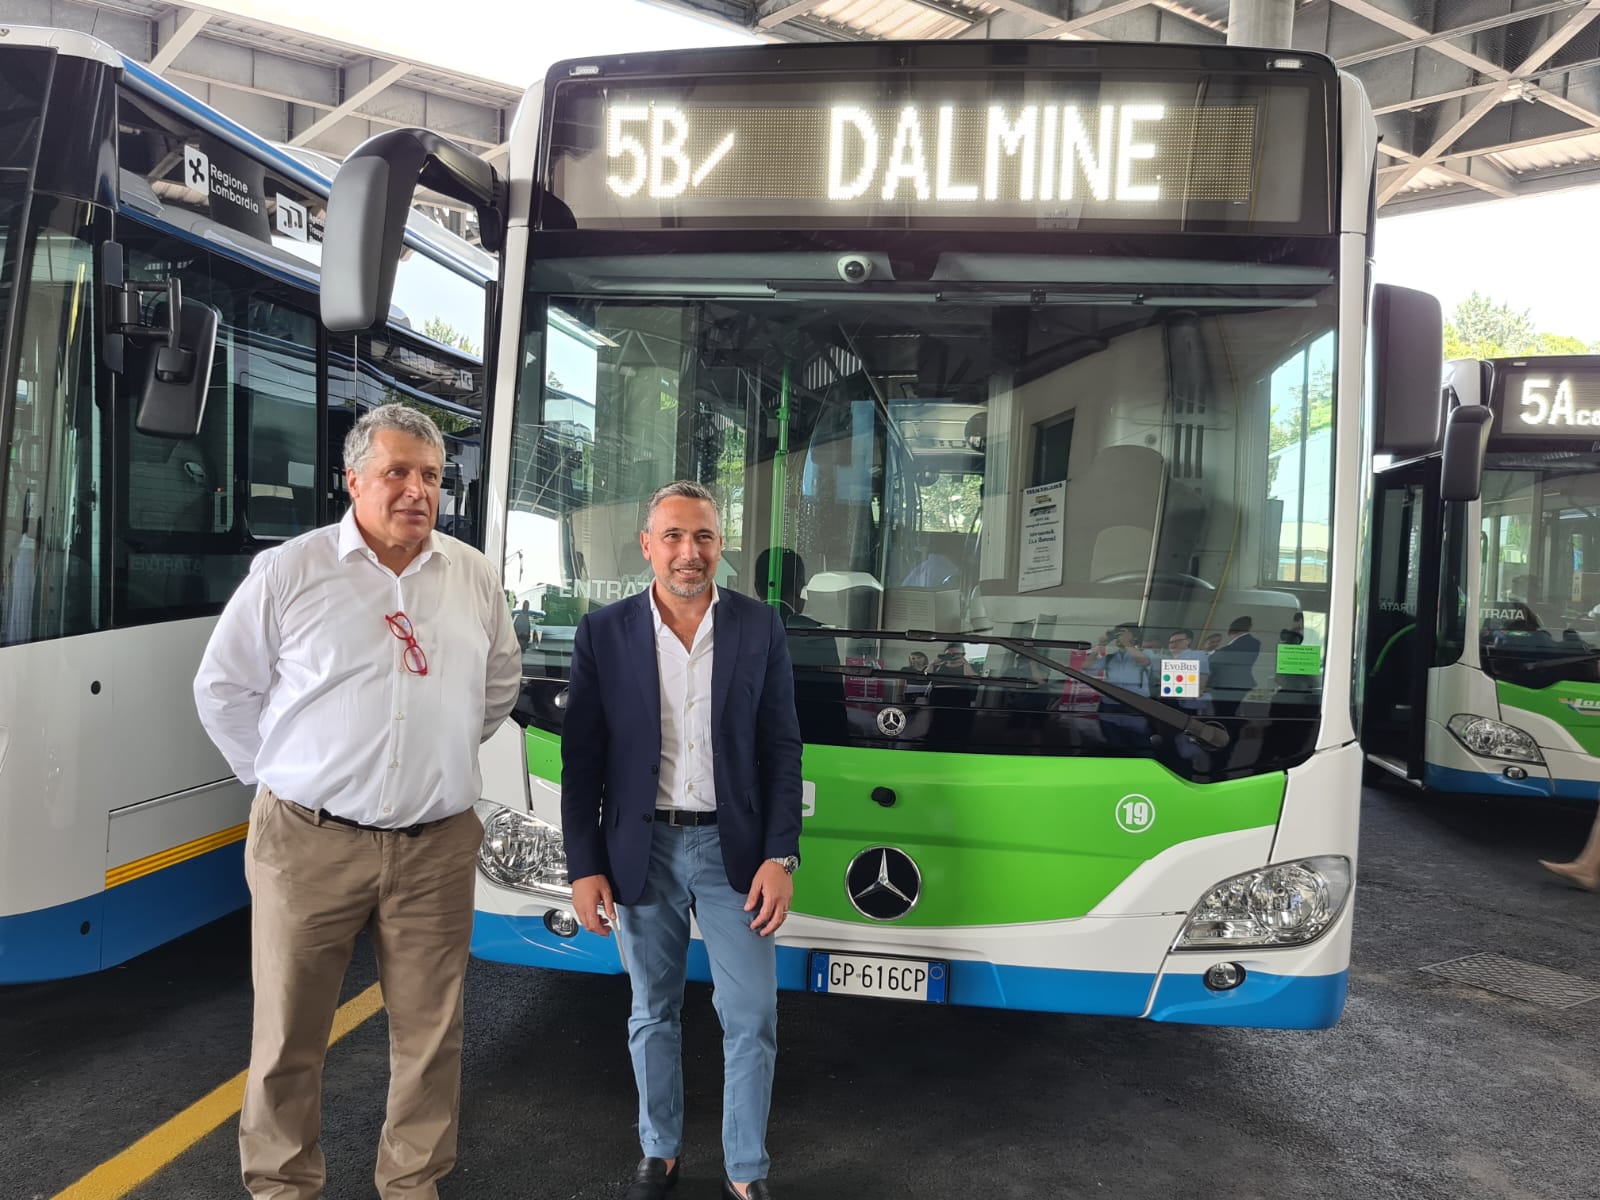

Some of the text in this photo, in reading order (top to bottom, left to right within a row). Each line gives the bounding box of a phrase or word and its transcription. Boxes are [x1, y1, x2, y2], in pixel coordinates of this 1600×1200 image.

[827, 104, 1165, 200] DALMINE
[210, 164, 248, 193] Regione
[210, 179, 259, 214] Lombardia
[1520, 379, 1574, 425] 5A
[1122, 802, 1149, 825] 19
